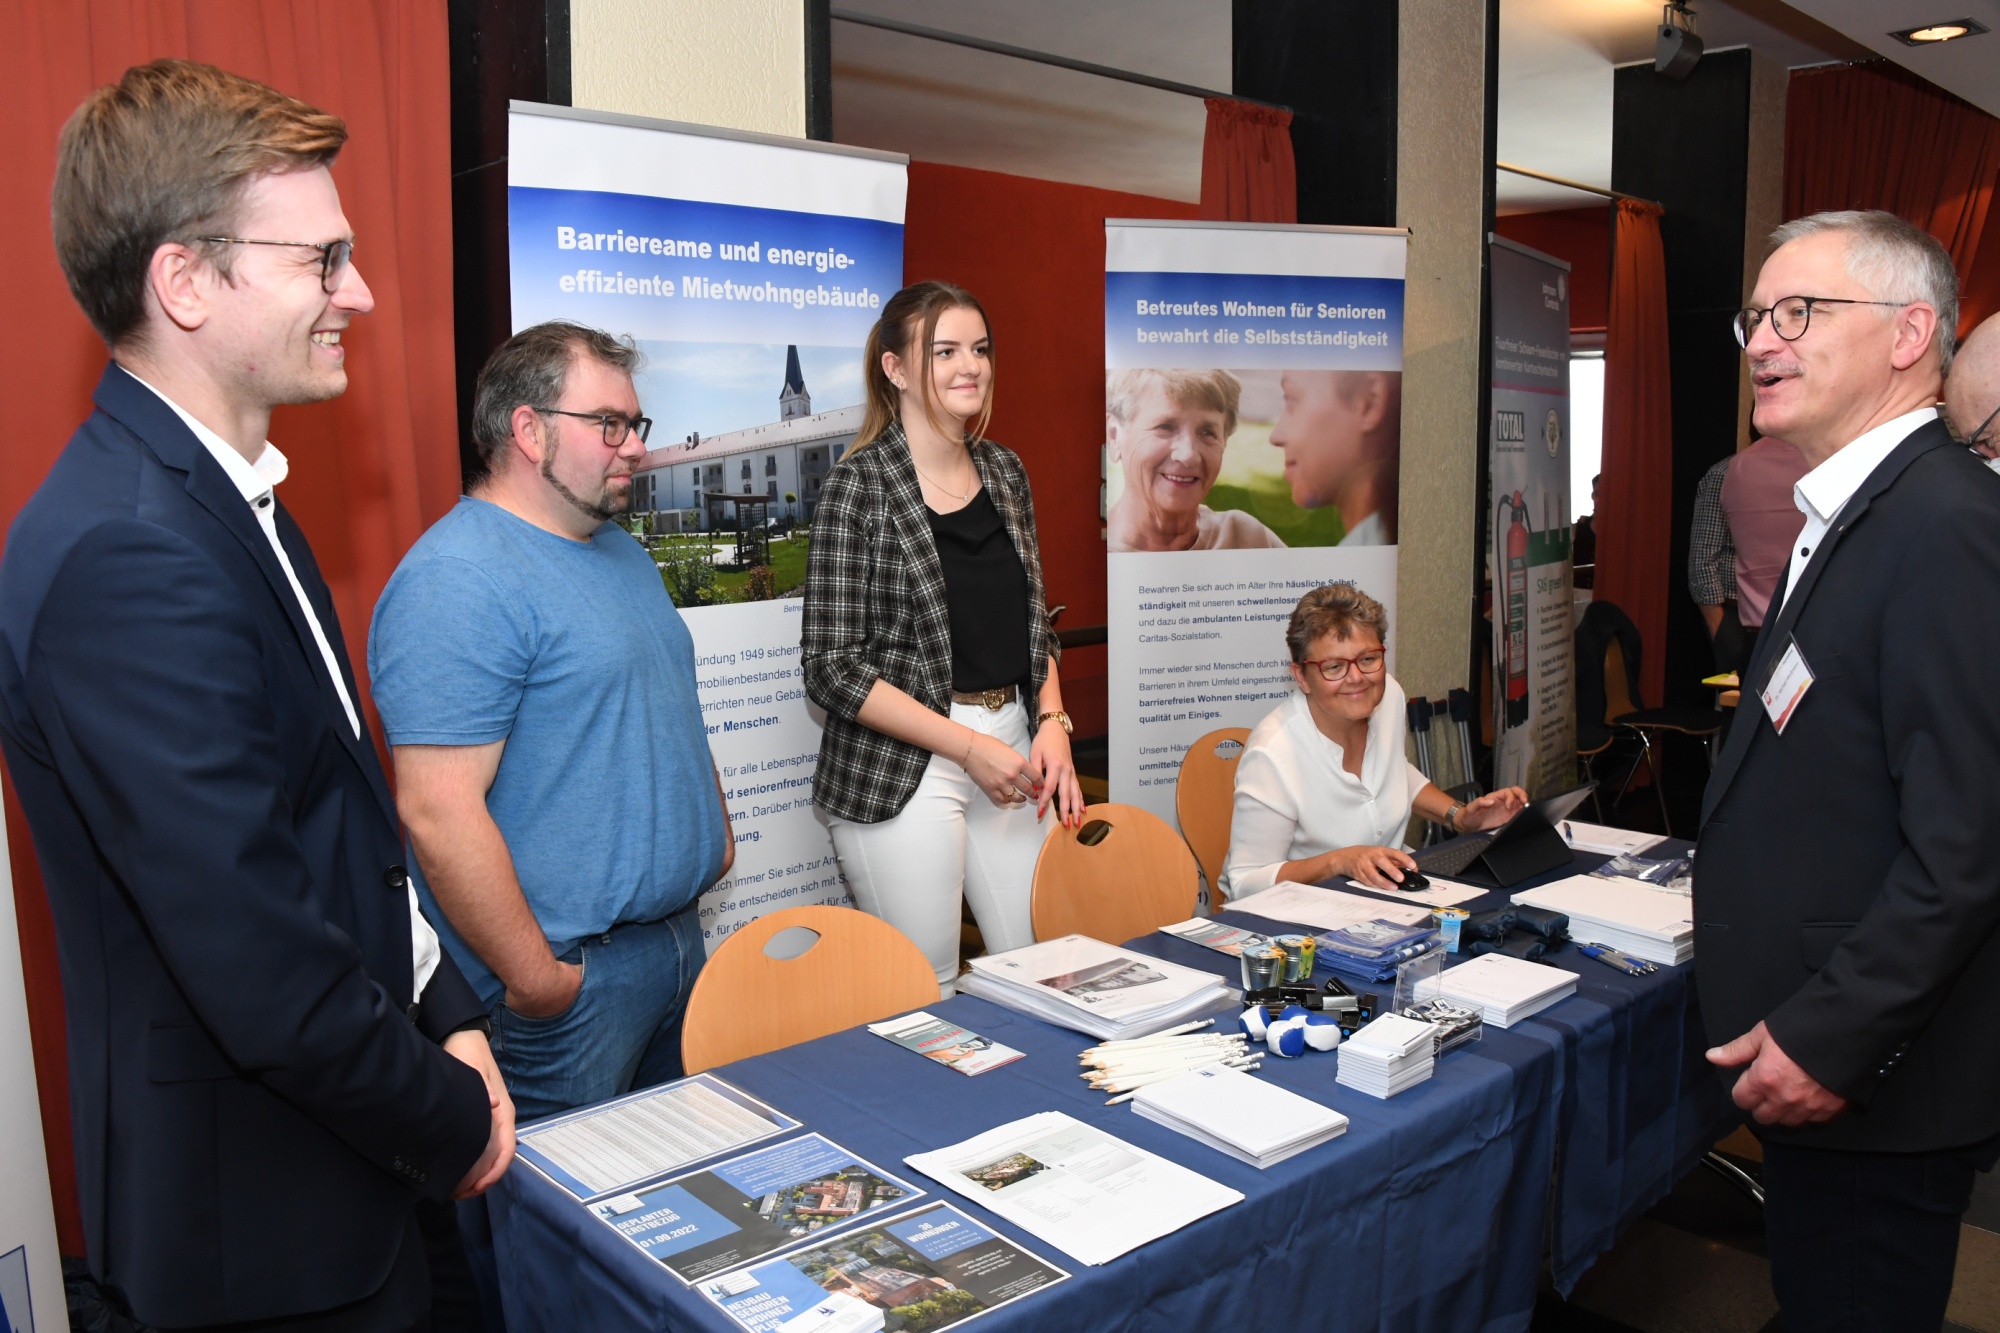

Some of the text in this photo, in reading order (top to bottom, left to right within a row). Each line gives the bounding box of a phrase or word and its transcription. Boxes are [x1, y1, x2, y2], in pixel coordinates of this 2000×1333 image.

[557, 226, 855, 273] Barriereame und energie-
[559, 269, 880, 310] effiziente Mietwohngebäude
[1136, 300, 1386, 320] Betreutes Wohnen für Senioren
[1137, 328, 1388, 349] bewahrt die Selbstständigkeit
[1497, 413, 1524, 440] TOTAL
[1139, 585, 1180, 594] Bewahren
[1182, 584, 1195, 593] Sie
[1196, 583, 1213, 592] sich
[1214, 582, 1234, 591] auch
[1236, 582, 1246, 590] im
[1248, 581, 1266, 590] Alter
[1268, 581, 1284, 589] Ihre
[1286, 579, 1325, 588] häusliche
[783, 604, 803, 613] Betre
[1139, 600, 1187, 611] ständigkeit
[1188, 600, 1201, 608] mit
[1202, 600, 1235, 608] unseren
[1139, 618, 1155, 627] und
[1157, 617, 1177, 626] dazu
[1178, 616, 1190, 625] die
[1192, 614, 1242, 624] ambulanten
[1139, 631, 1222, 643] Caritas-Sozialstation.
[695, 645, 803, 666] ündung 1949 sichern
[1139, 667, 1165, 676] Immer
[1167, 664, 1192, 673] wieder
[1194, 663, 1211, 672] sind
[1214, 661, 1254, 670] Menschen
[1257, 660, 1278, 669] durch
[1139, 675, 1296, 691] Barrieren in ihrem Umfeld eingeschränk
[700, 698, 744, 713] errichten
[747, 694, 773, 706] neue
[1139, 695, 1195, 707] barrierefreies
[1198, 694, 1232, 703] Wohnen
[1235, 692, 1267, 702] steigert
[1269, 690, 1289, 699] auch
[723, 716, 781, 733] Menschen.
[1139, 710, 1222, 724] qualität um Einiges.
[1139, 744, 1192, 755] Unsere Häus
[723, 766, 738, 778] für
[740, 763, 758, 775] alle
[1139, 777, 1178, 786] bei denen
[752, 801, 792, 818] Darüber
[735, 872, 766, 888] immer
[768, 867, 784, 880] Sie
[786, 863, 804, 876] sich
[806, 859, 821, 871] zur
[697, 906, 717, 918] en,
[719, 901, 736, 914] Sie
[739, 885, 798, 908] entscheiden
[800, 879, 819, 894] sich
[821, 876, 836, 888] mit
[838, 873, 848, 884] S
[717, 925, 731, 936] für
[616, 1208, 673, 1230] GEPLANTER
[624, 1213, 680, 1236] ERSTBEZUG
[907, 1221, 960, 1243] WOHNUNGEN
[727, 1292, 771, 1311] NEUBAU
[736, 1295, 790, 1319] SENIOREN
[743, 1305, 793, 1326] WOHNEN
[753, 1319, 780, 1333] PLUS
